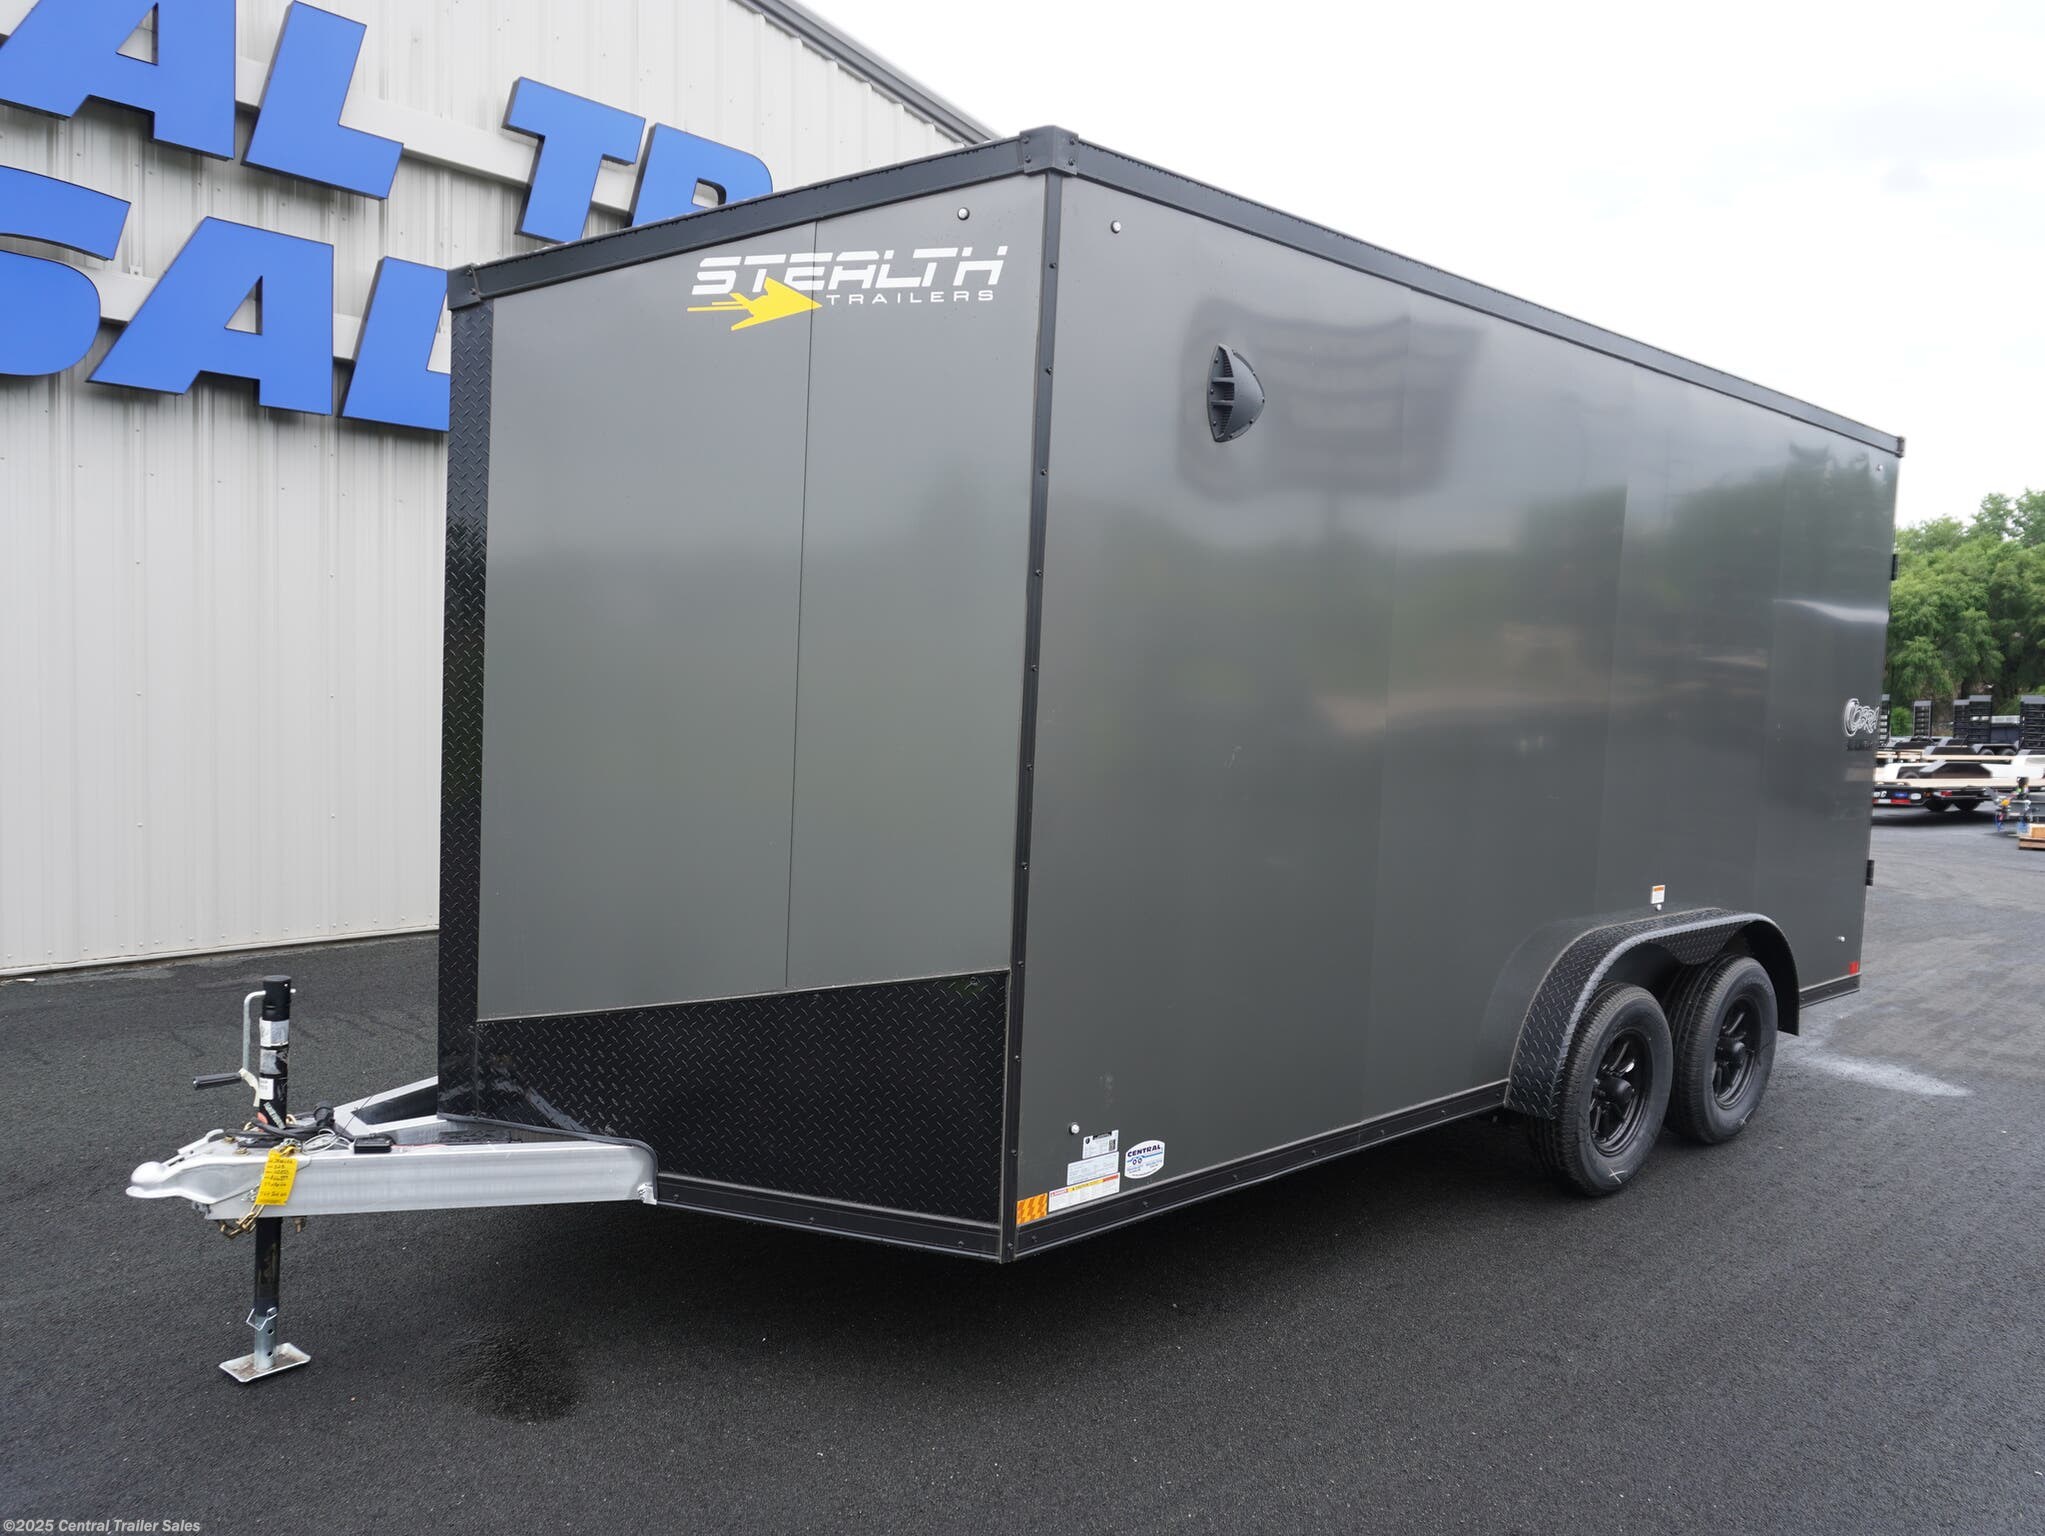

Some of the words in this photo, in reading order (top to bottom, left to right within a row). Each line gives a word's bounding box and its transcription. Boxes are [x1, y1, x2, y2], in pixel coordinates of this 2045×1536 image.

[691, 246, 1008, 295] STEALTH
[826, 290, 994, 306] TRAILERS
[1127, 1144, 1161, 1157] CENTRAL
